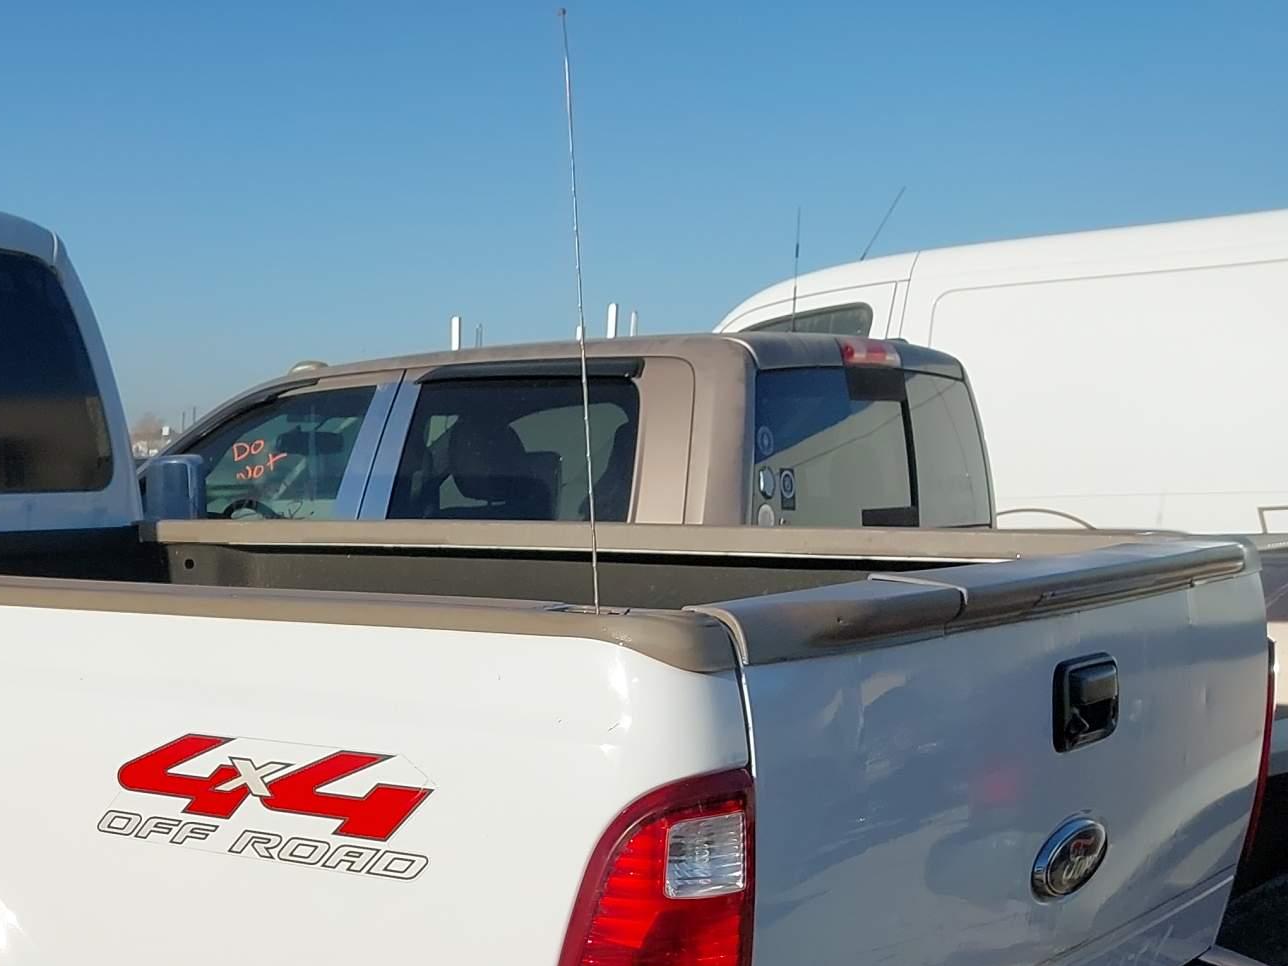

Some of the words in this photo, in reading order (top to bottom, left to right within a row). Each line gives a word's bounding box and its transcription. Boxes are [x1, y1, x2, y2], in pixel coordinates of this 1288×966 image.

[232, 439, 265, 462] DO
[97, 809, 219, 844] OFF
[228, 829, 429, 881] ROAD
